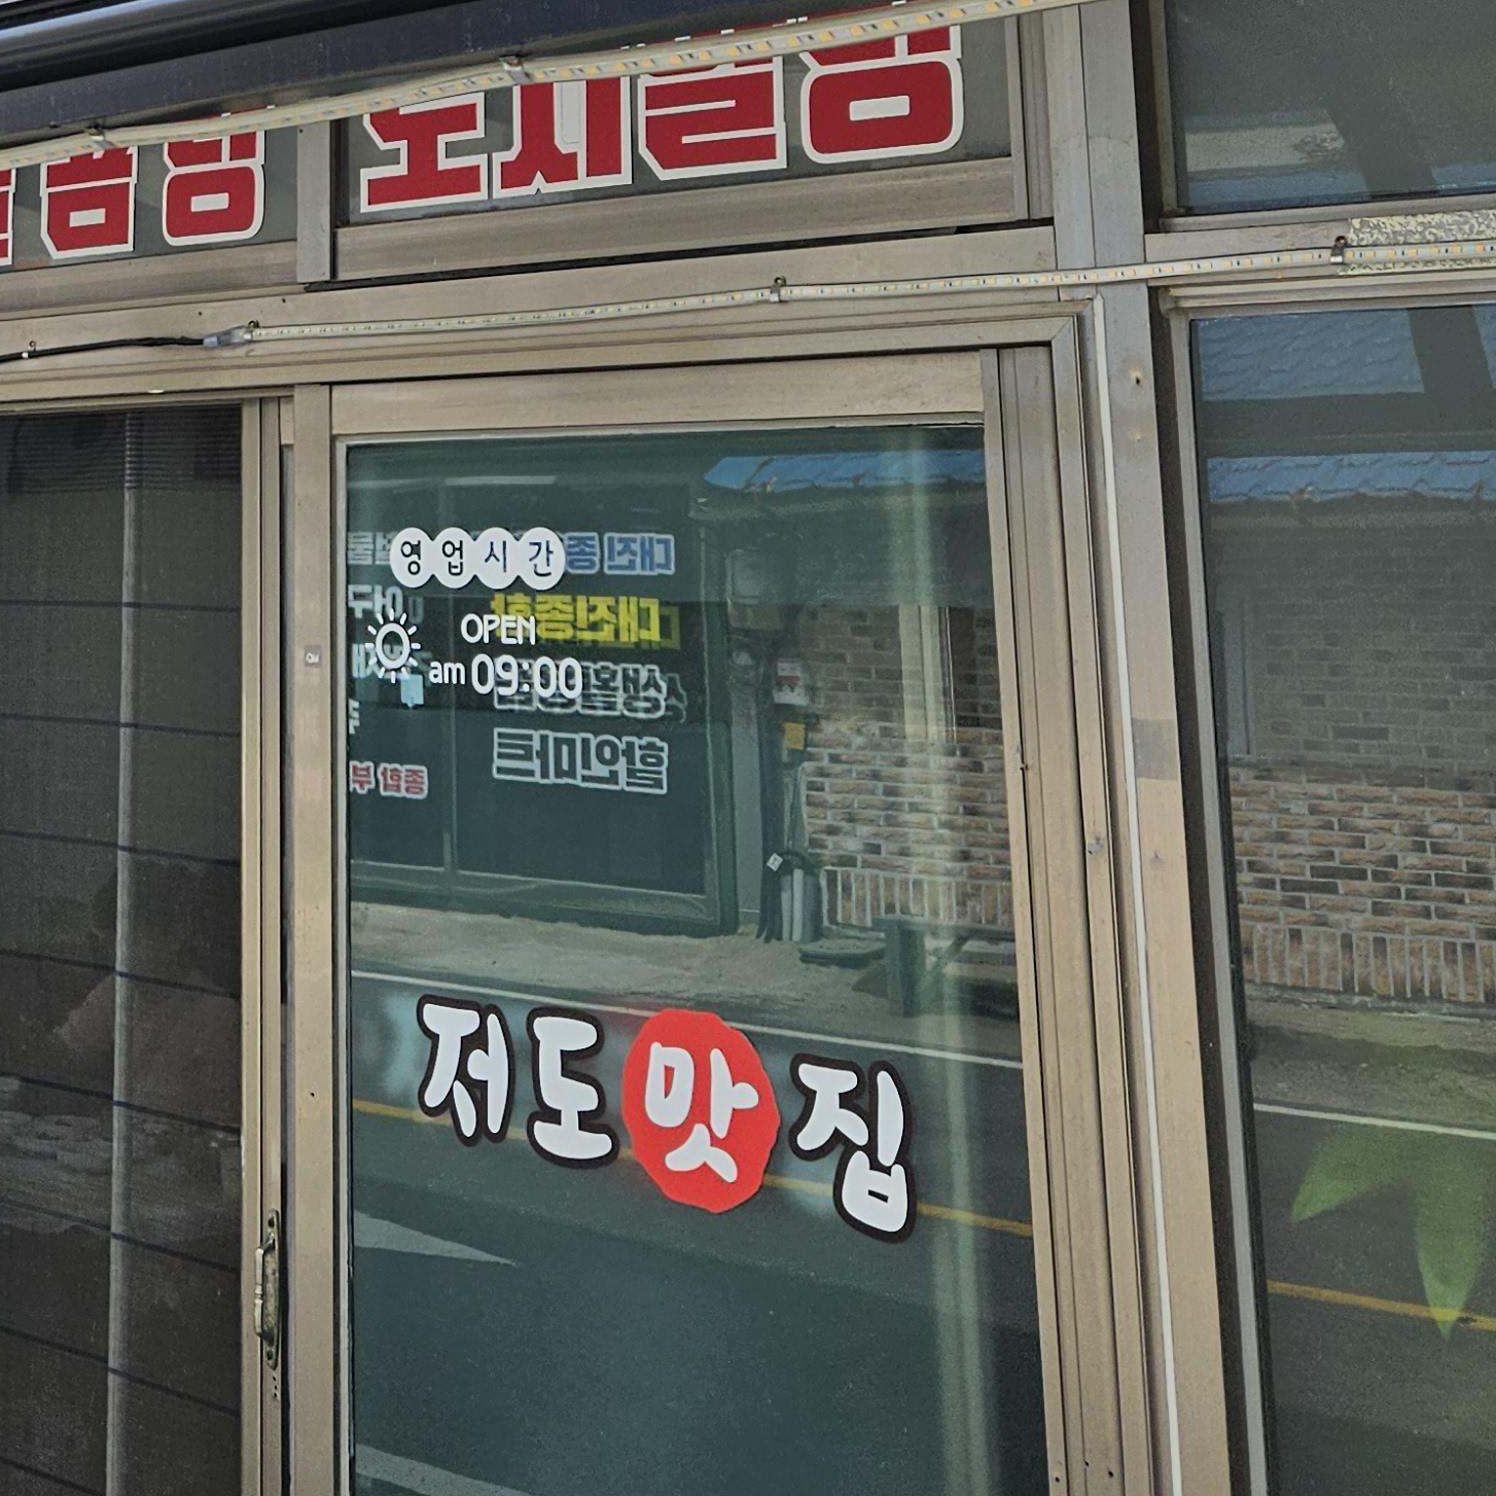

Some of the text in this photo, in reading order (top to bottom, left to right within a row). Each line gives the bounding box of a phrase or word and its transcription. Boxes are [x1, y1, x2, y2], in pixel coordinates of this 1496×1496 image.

[400, 538, 555, 577] 영업시간
[461, 613, 536, 646] OPEN
[429, 660, 466, 685] am
[471, 653, 583, 699] 09:00
[418, 998, 913, 1240] 저도맛집
